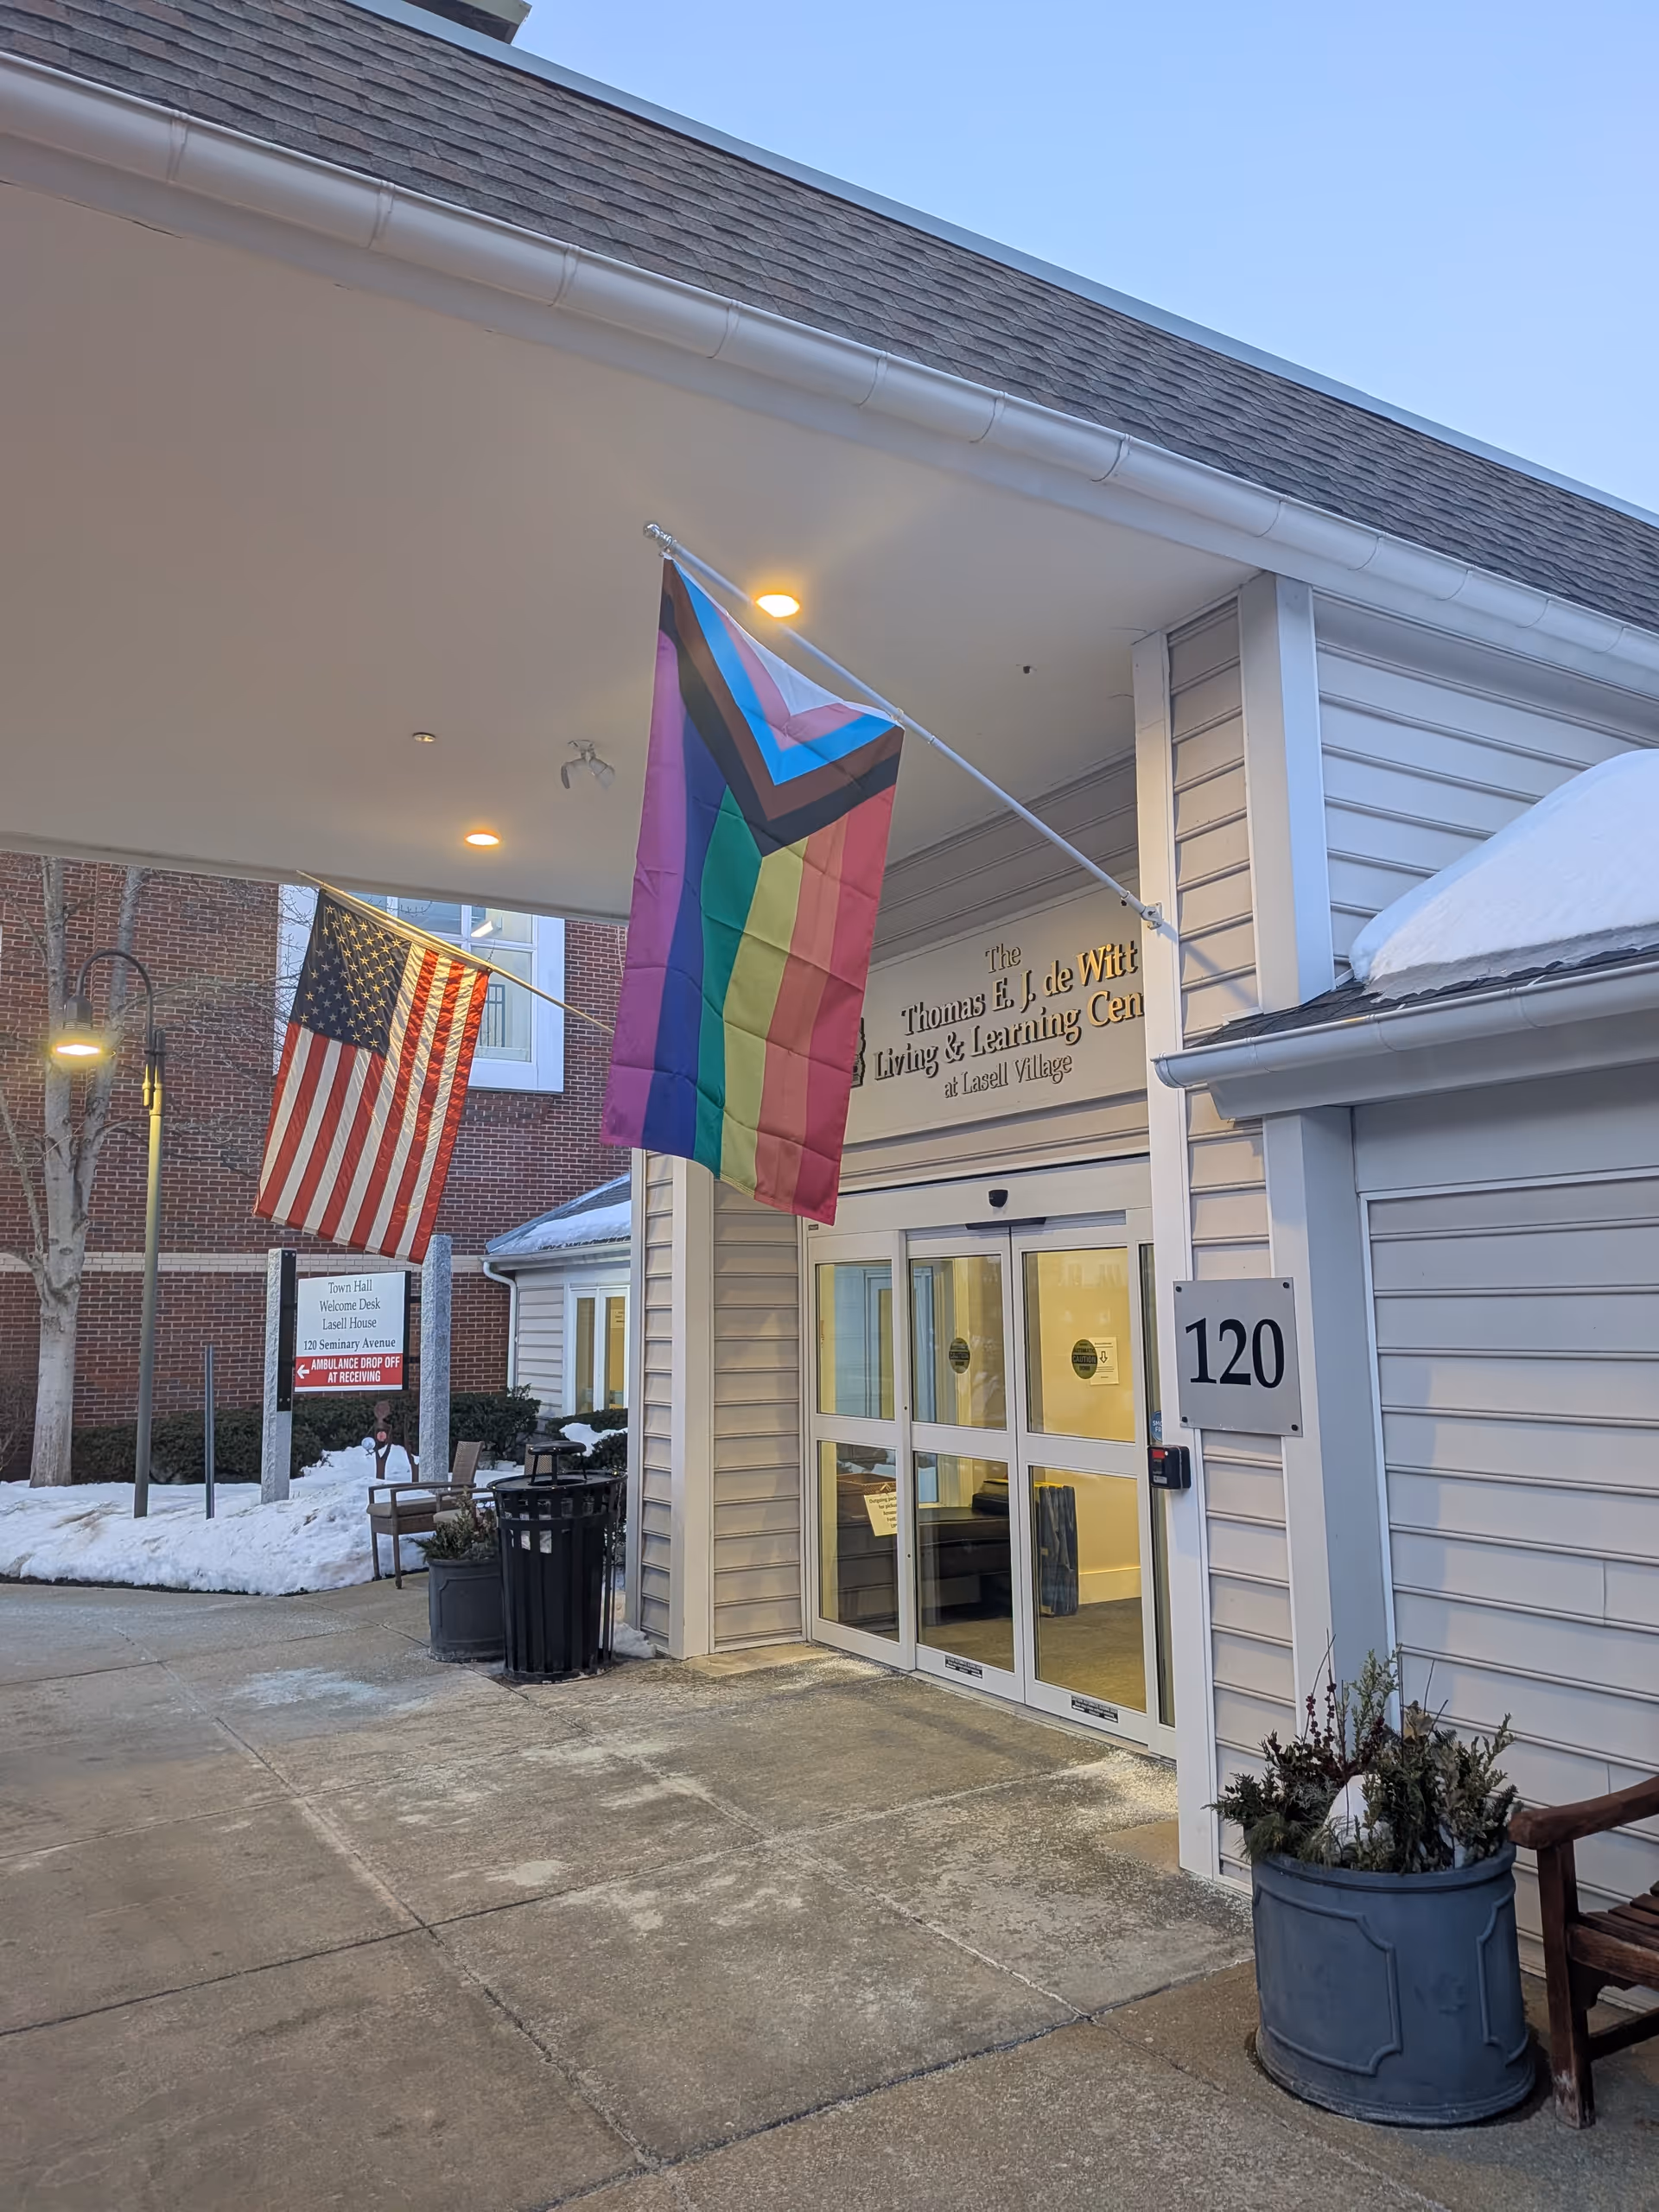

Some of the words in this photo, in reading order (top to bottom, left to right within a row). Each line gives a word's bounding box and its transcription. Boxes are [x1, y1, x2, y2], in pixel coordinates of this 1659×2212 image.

[985, 943, 1022, 974] The
[901, 993, 987, 1036] Thomas
[992, 976, 1014, 1012] E.
[1020, 969, 1036, 1013] J.
[1041, 960, 1073, 997] de
[1077, 940, 1139, 987] Witt
[873, 1043, 939, 1080] Living
[944, 1032, 964, 1063] &
[969, 1007, 1082, 1058] Learning
[1086, 991, 1145, 1027] Cen
[944, 1075, 958, 1098] at
[962, 1062, 1008, 1095] Lasell
[1014, 1053, 1072, 1084] Village
[328, 1281, 352, 1294] Town
[354, 1279, 372, 1293] Hall
[320, 1300, 357, 1313] Welcome
[359, 1297, 381, 1310] Desk
[322, 1318, 346, 1331] Lasell
[349, 1317, 377, 1329] House
[303, 1340, 317, 1351] 120
[320, 1338, 360, 1351] Seminary
[362, 1338, 396, 1348] Avenue
[1072, 1355, 1096, 1363] CAUTION
[1185, 1317, 1285, 1389] 120
[311, 1357, 359, 1370] AMBULANCE
[360, 1357, 382, 1369] DROP
[385, 1356, 400, 1368] OFF
[327, 1372, 337, 1383] AT
[340, 1370, 381, 1383] RECEIVING
